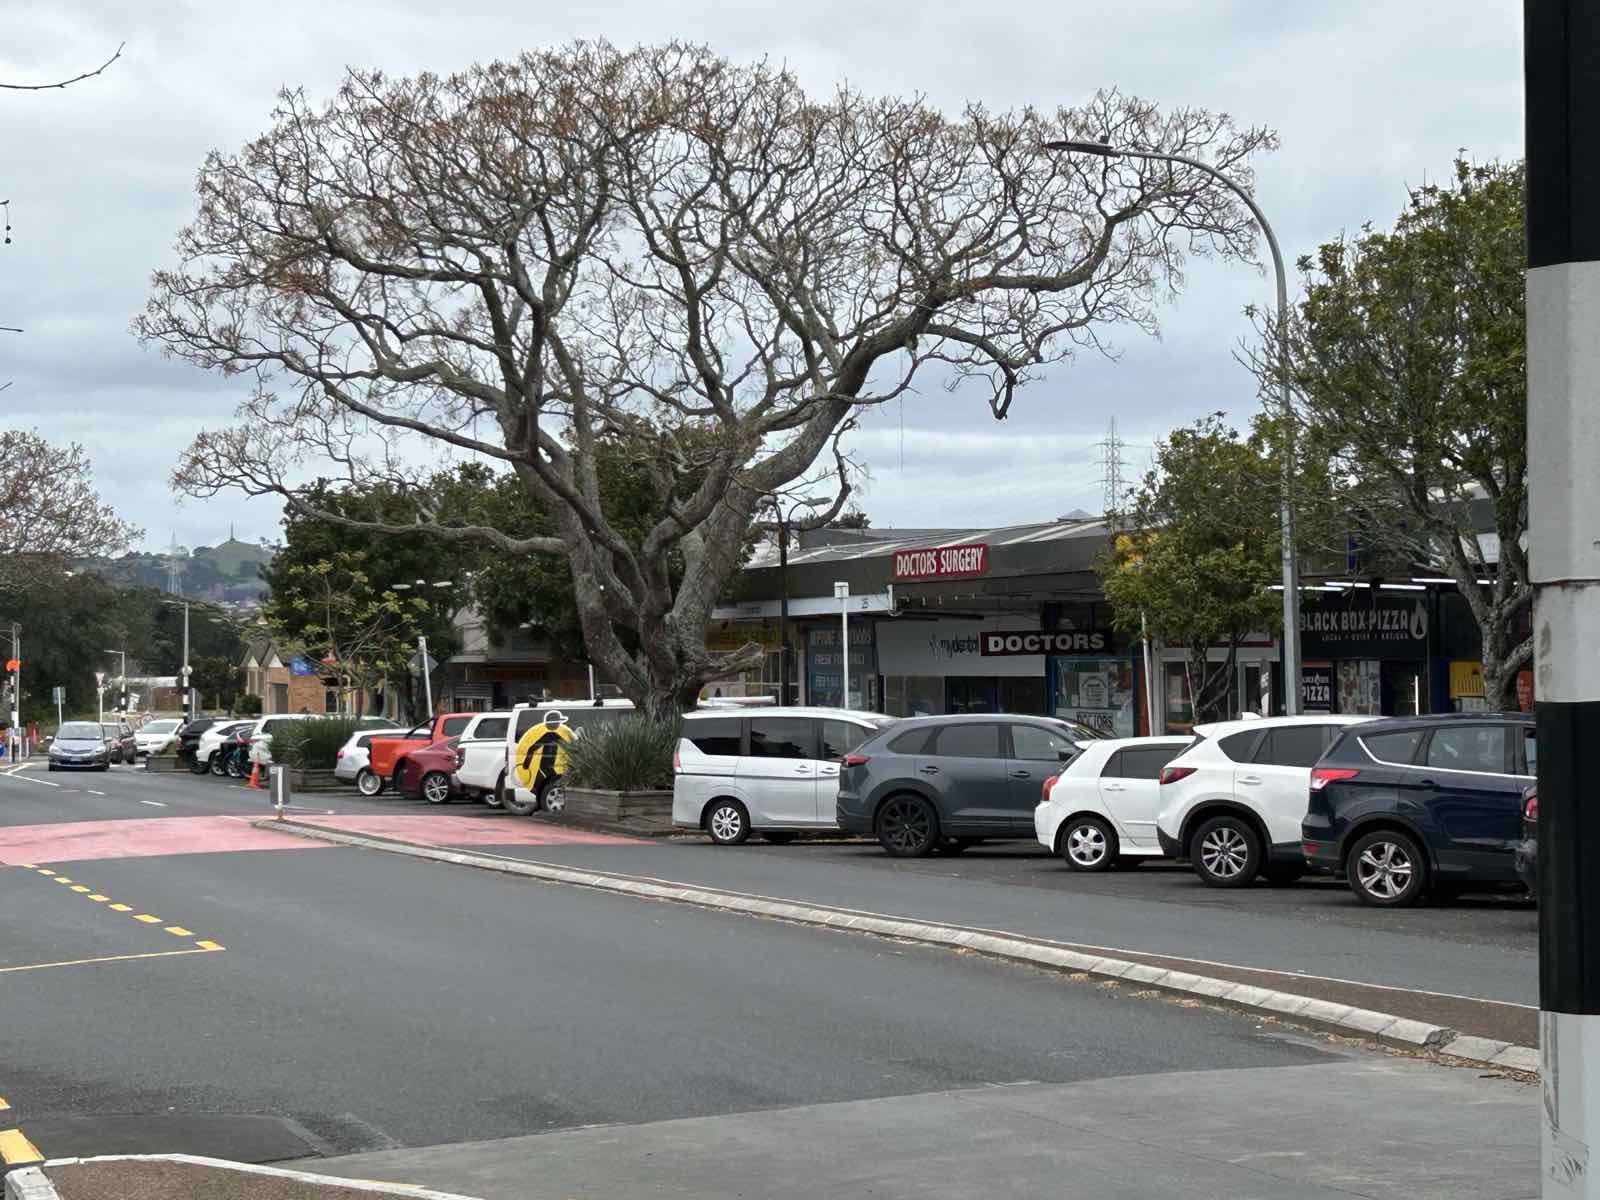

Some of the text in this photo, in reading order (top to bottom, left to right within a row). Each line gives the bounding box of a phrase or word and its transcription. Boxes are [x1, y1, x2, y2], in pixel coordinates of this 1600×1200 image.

[896, 547, 983, 576] DOCTORS SURGERY
[1298, 609, 1408, 632] BLACK BOX PIZZA
[987, 634, 1105, 653] DOCTORS
